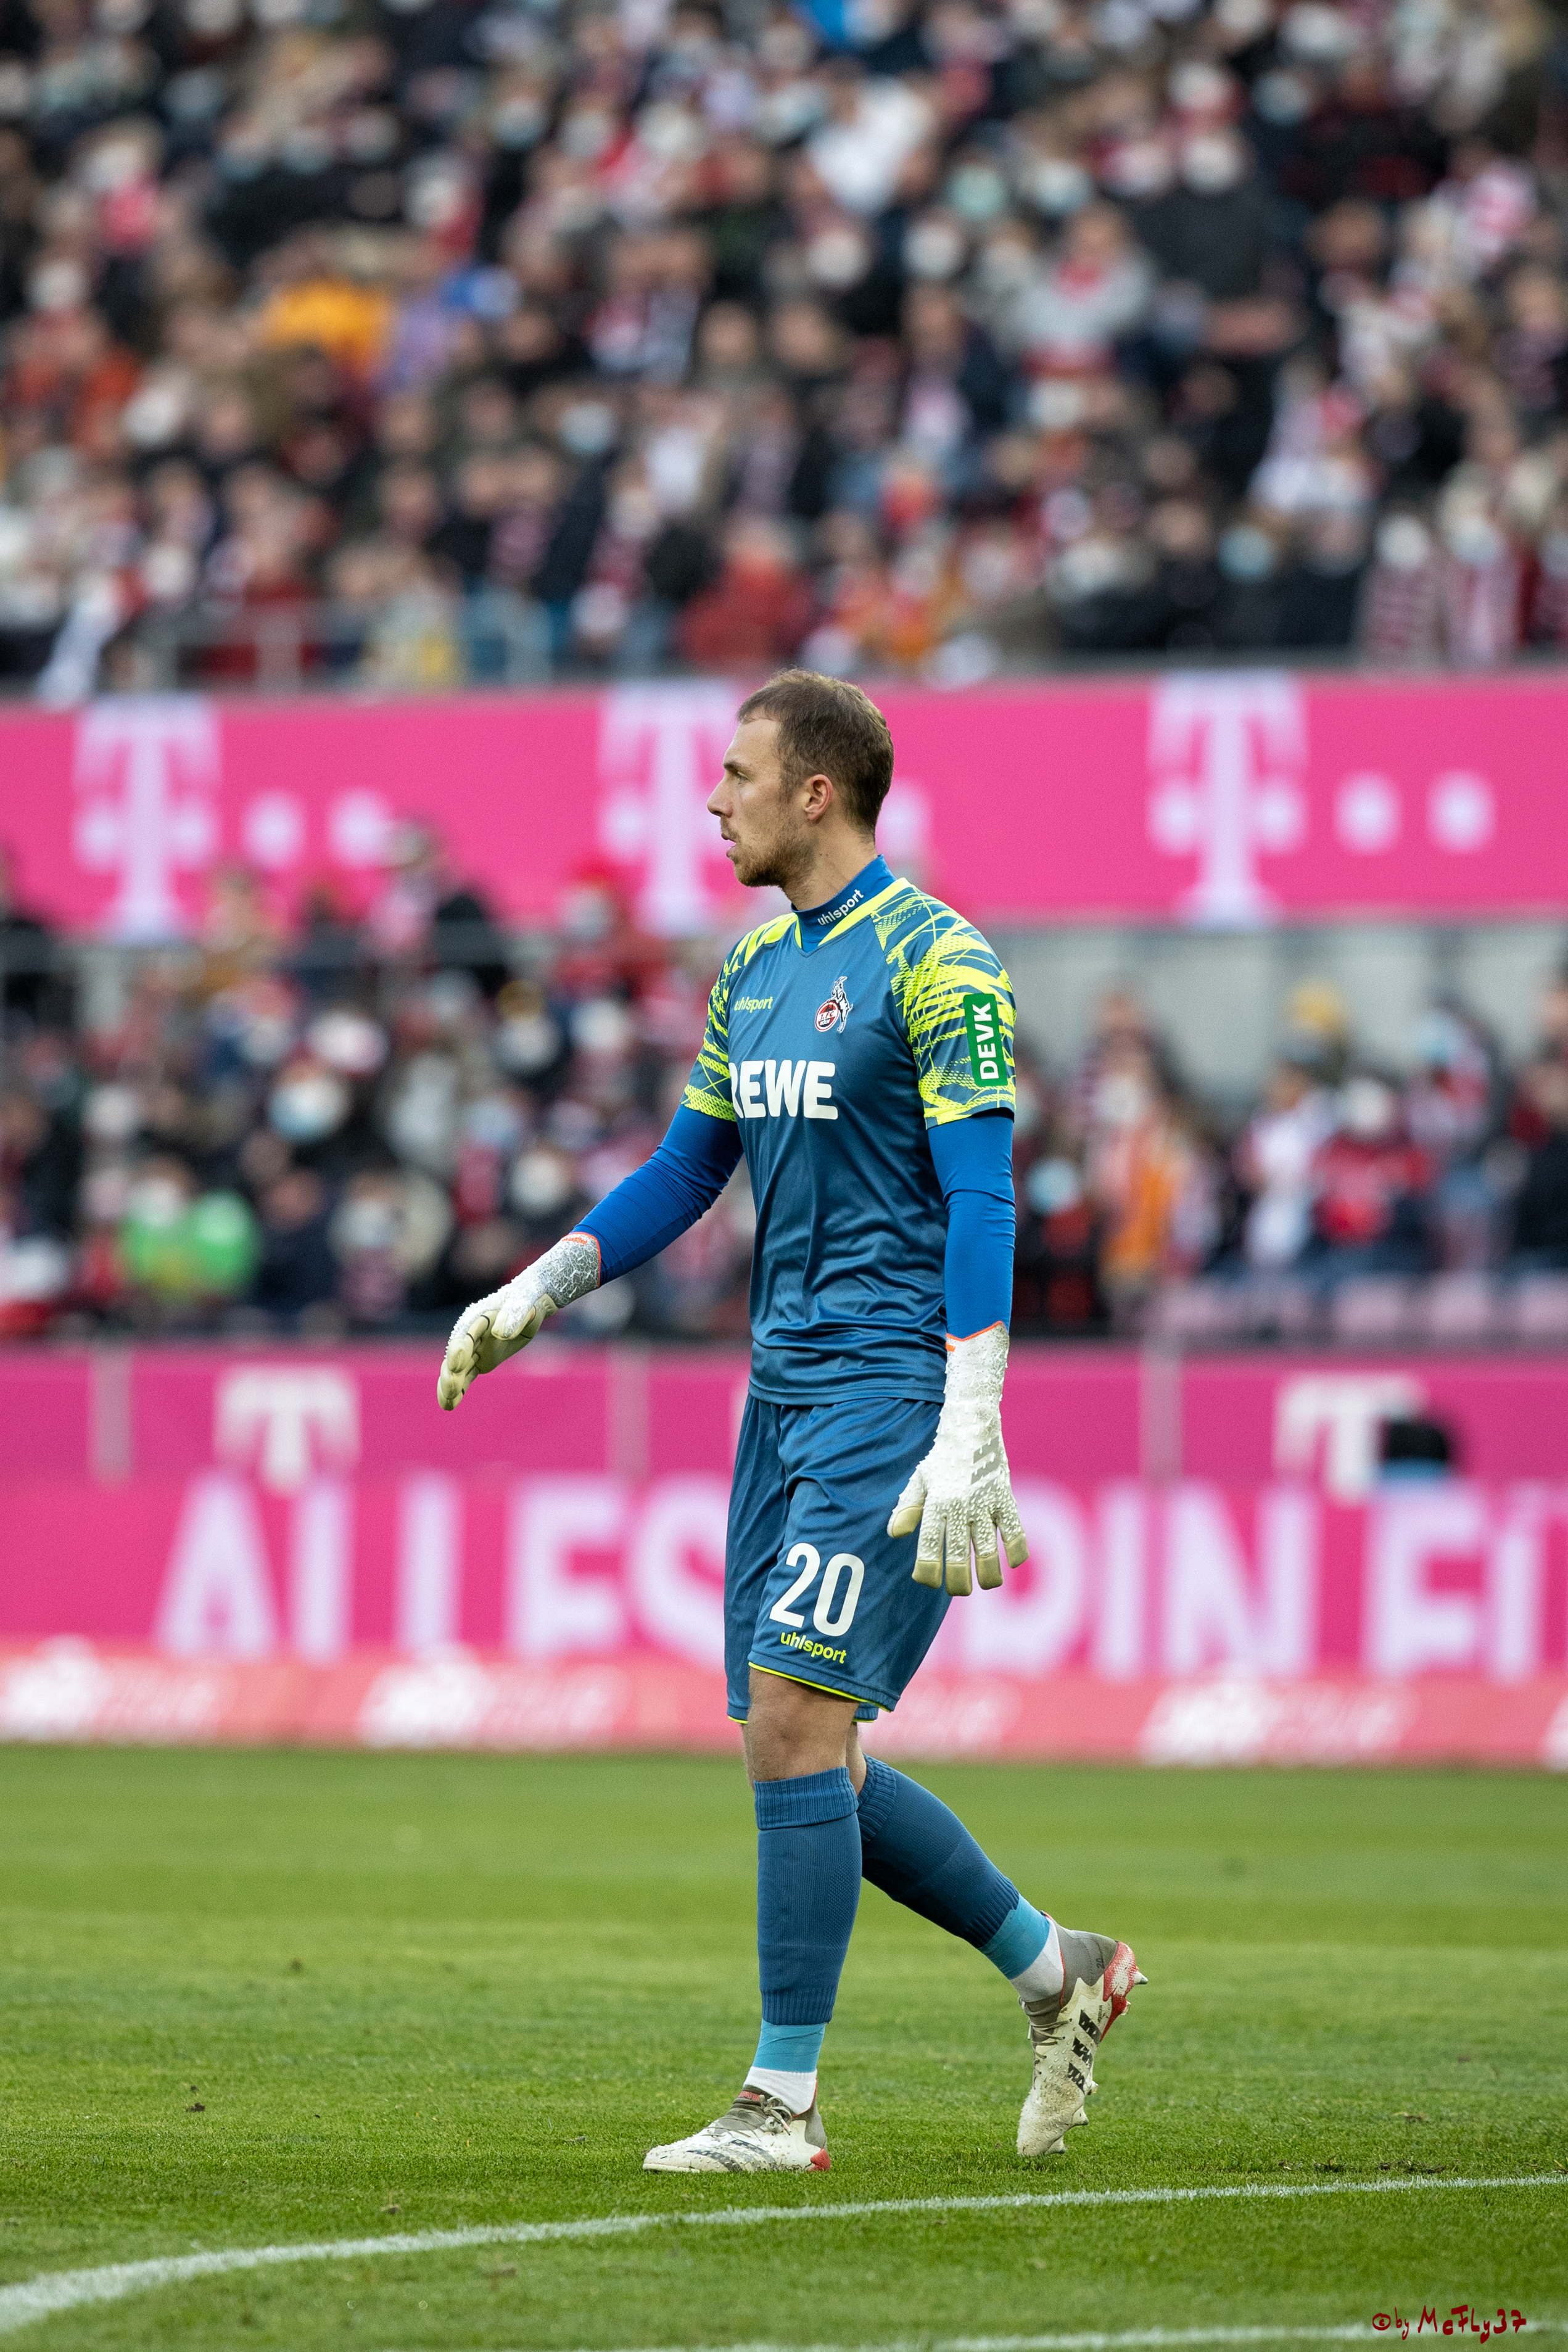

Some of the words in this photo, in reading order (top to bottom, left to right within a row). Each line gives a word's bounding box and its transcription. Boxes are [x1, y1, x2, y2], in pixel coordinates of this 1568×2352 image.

[817, 889, 864, 925] uhlsport
[734, 996, 773, 1013] uhlsport
[972, 1002, 999, 1079] DEVK
[769, 1543, 865, 1636] 20
[780, 1632, 846, 1664] uhlsport
